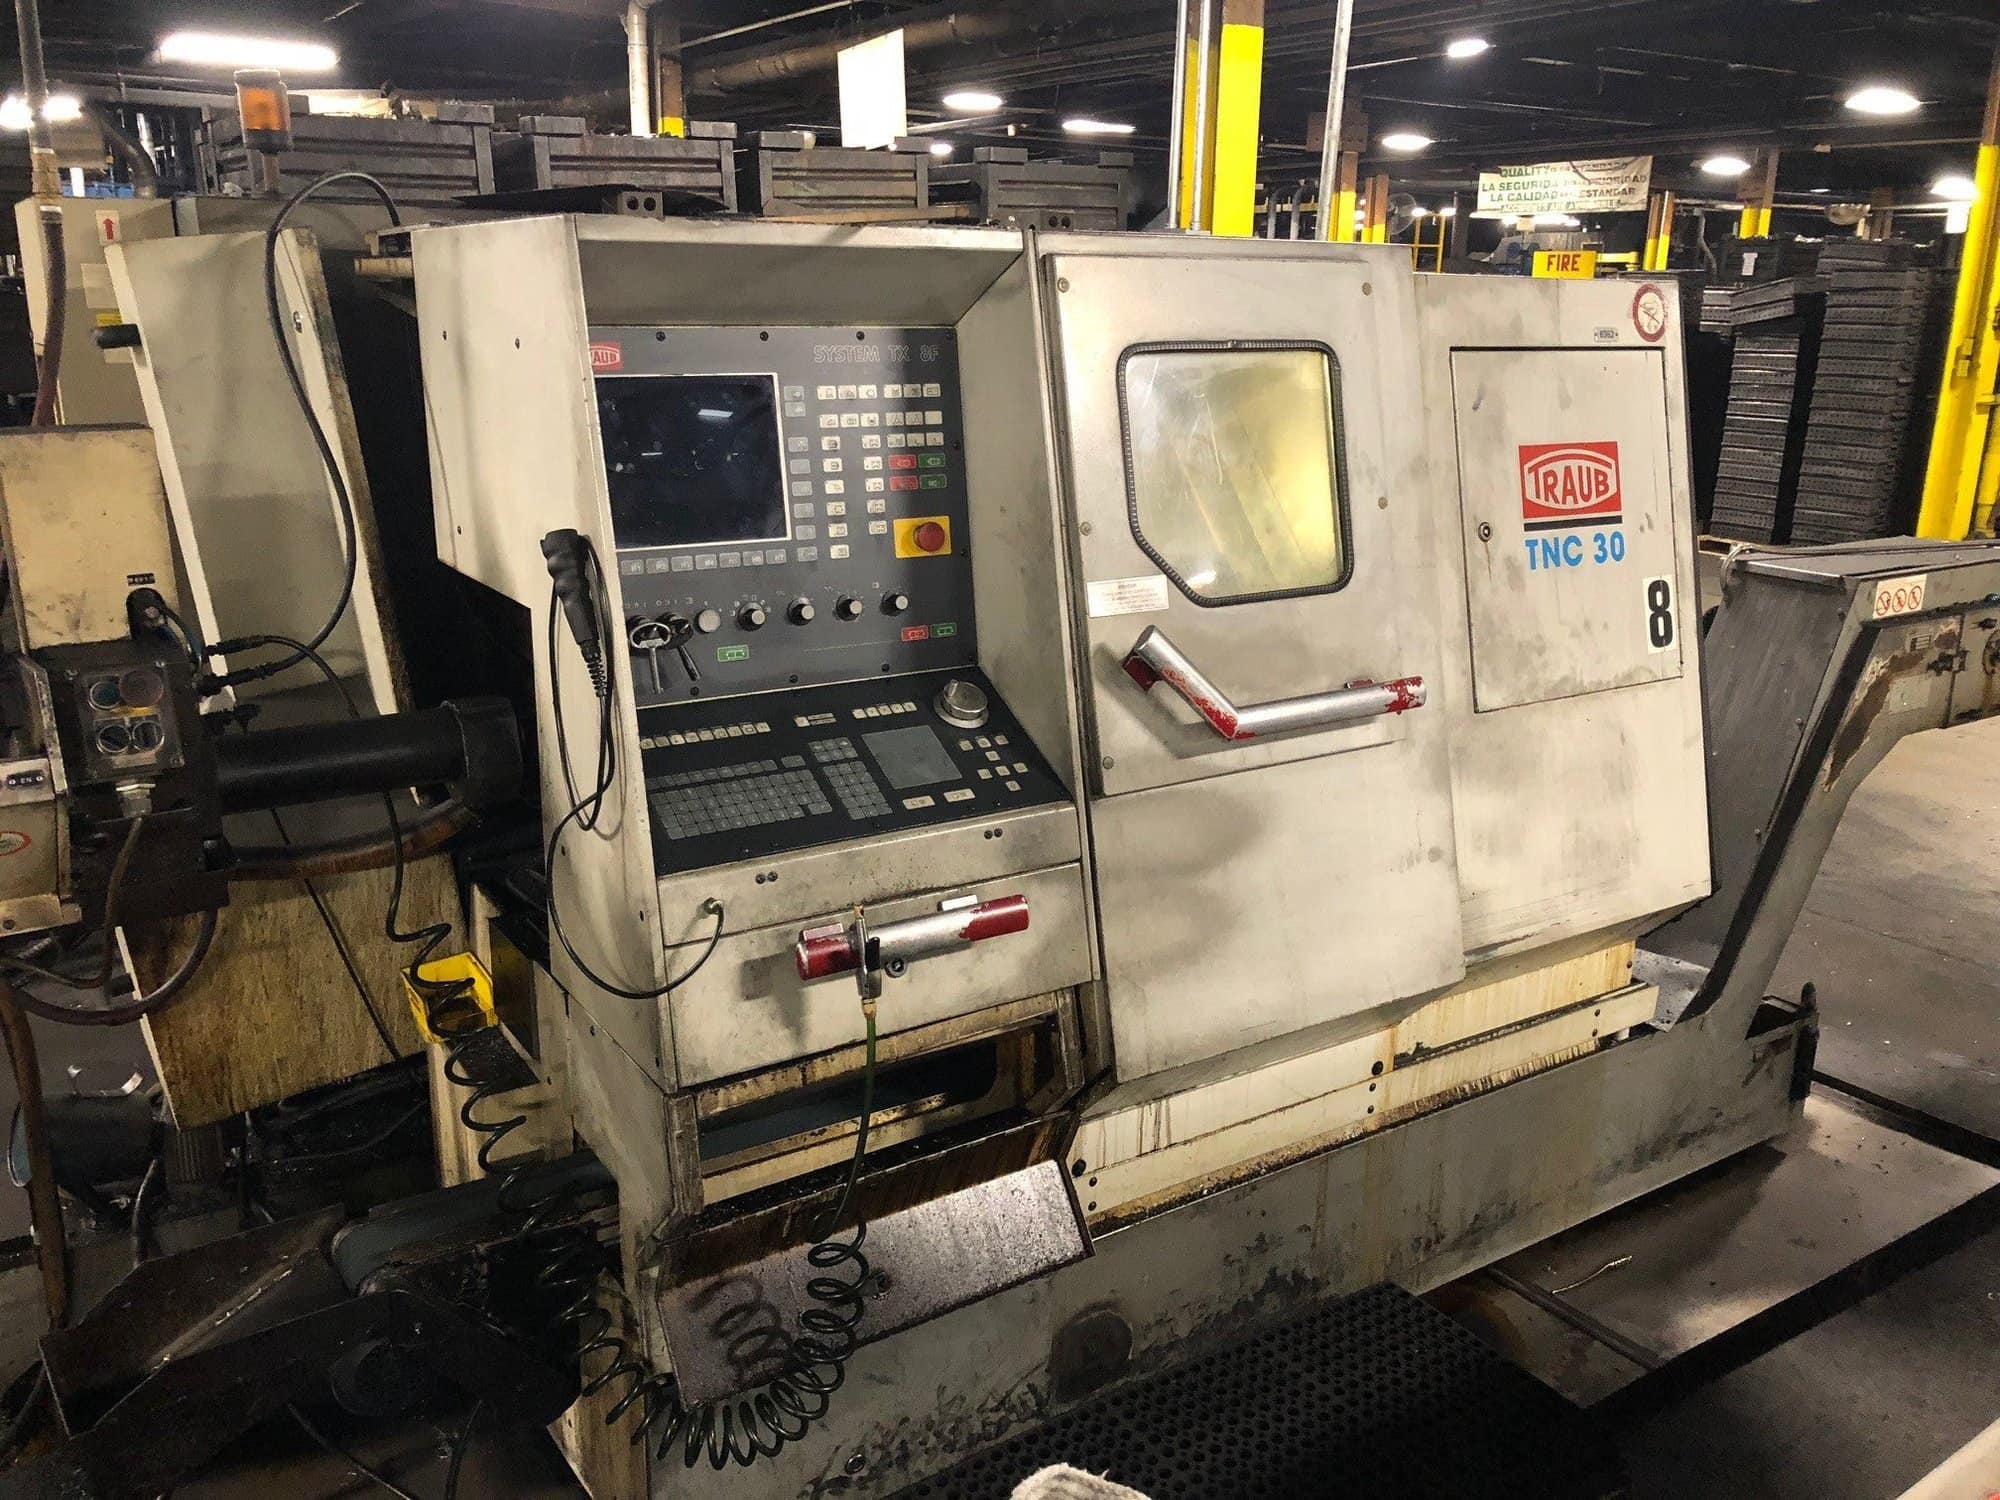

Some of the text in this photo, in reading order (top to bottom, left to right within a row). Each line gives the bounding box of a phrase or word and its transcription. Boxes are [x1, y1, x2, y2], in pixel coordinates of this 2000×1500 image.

[1482, 183, 1496, 192] LA
[1490, 193, 1504, 202] LA
[1507, 190, 1558, 201] CALIDAD
[1547, 254, 1581, 272] FIRE
[814, 344, 940, 363] SYSTEM TX 8F
[1528, 455, 1612, 504] TRAUB
[1525, 531, 1625, 570] TNC 30
[1647, 579, 1674, 648] 8
